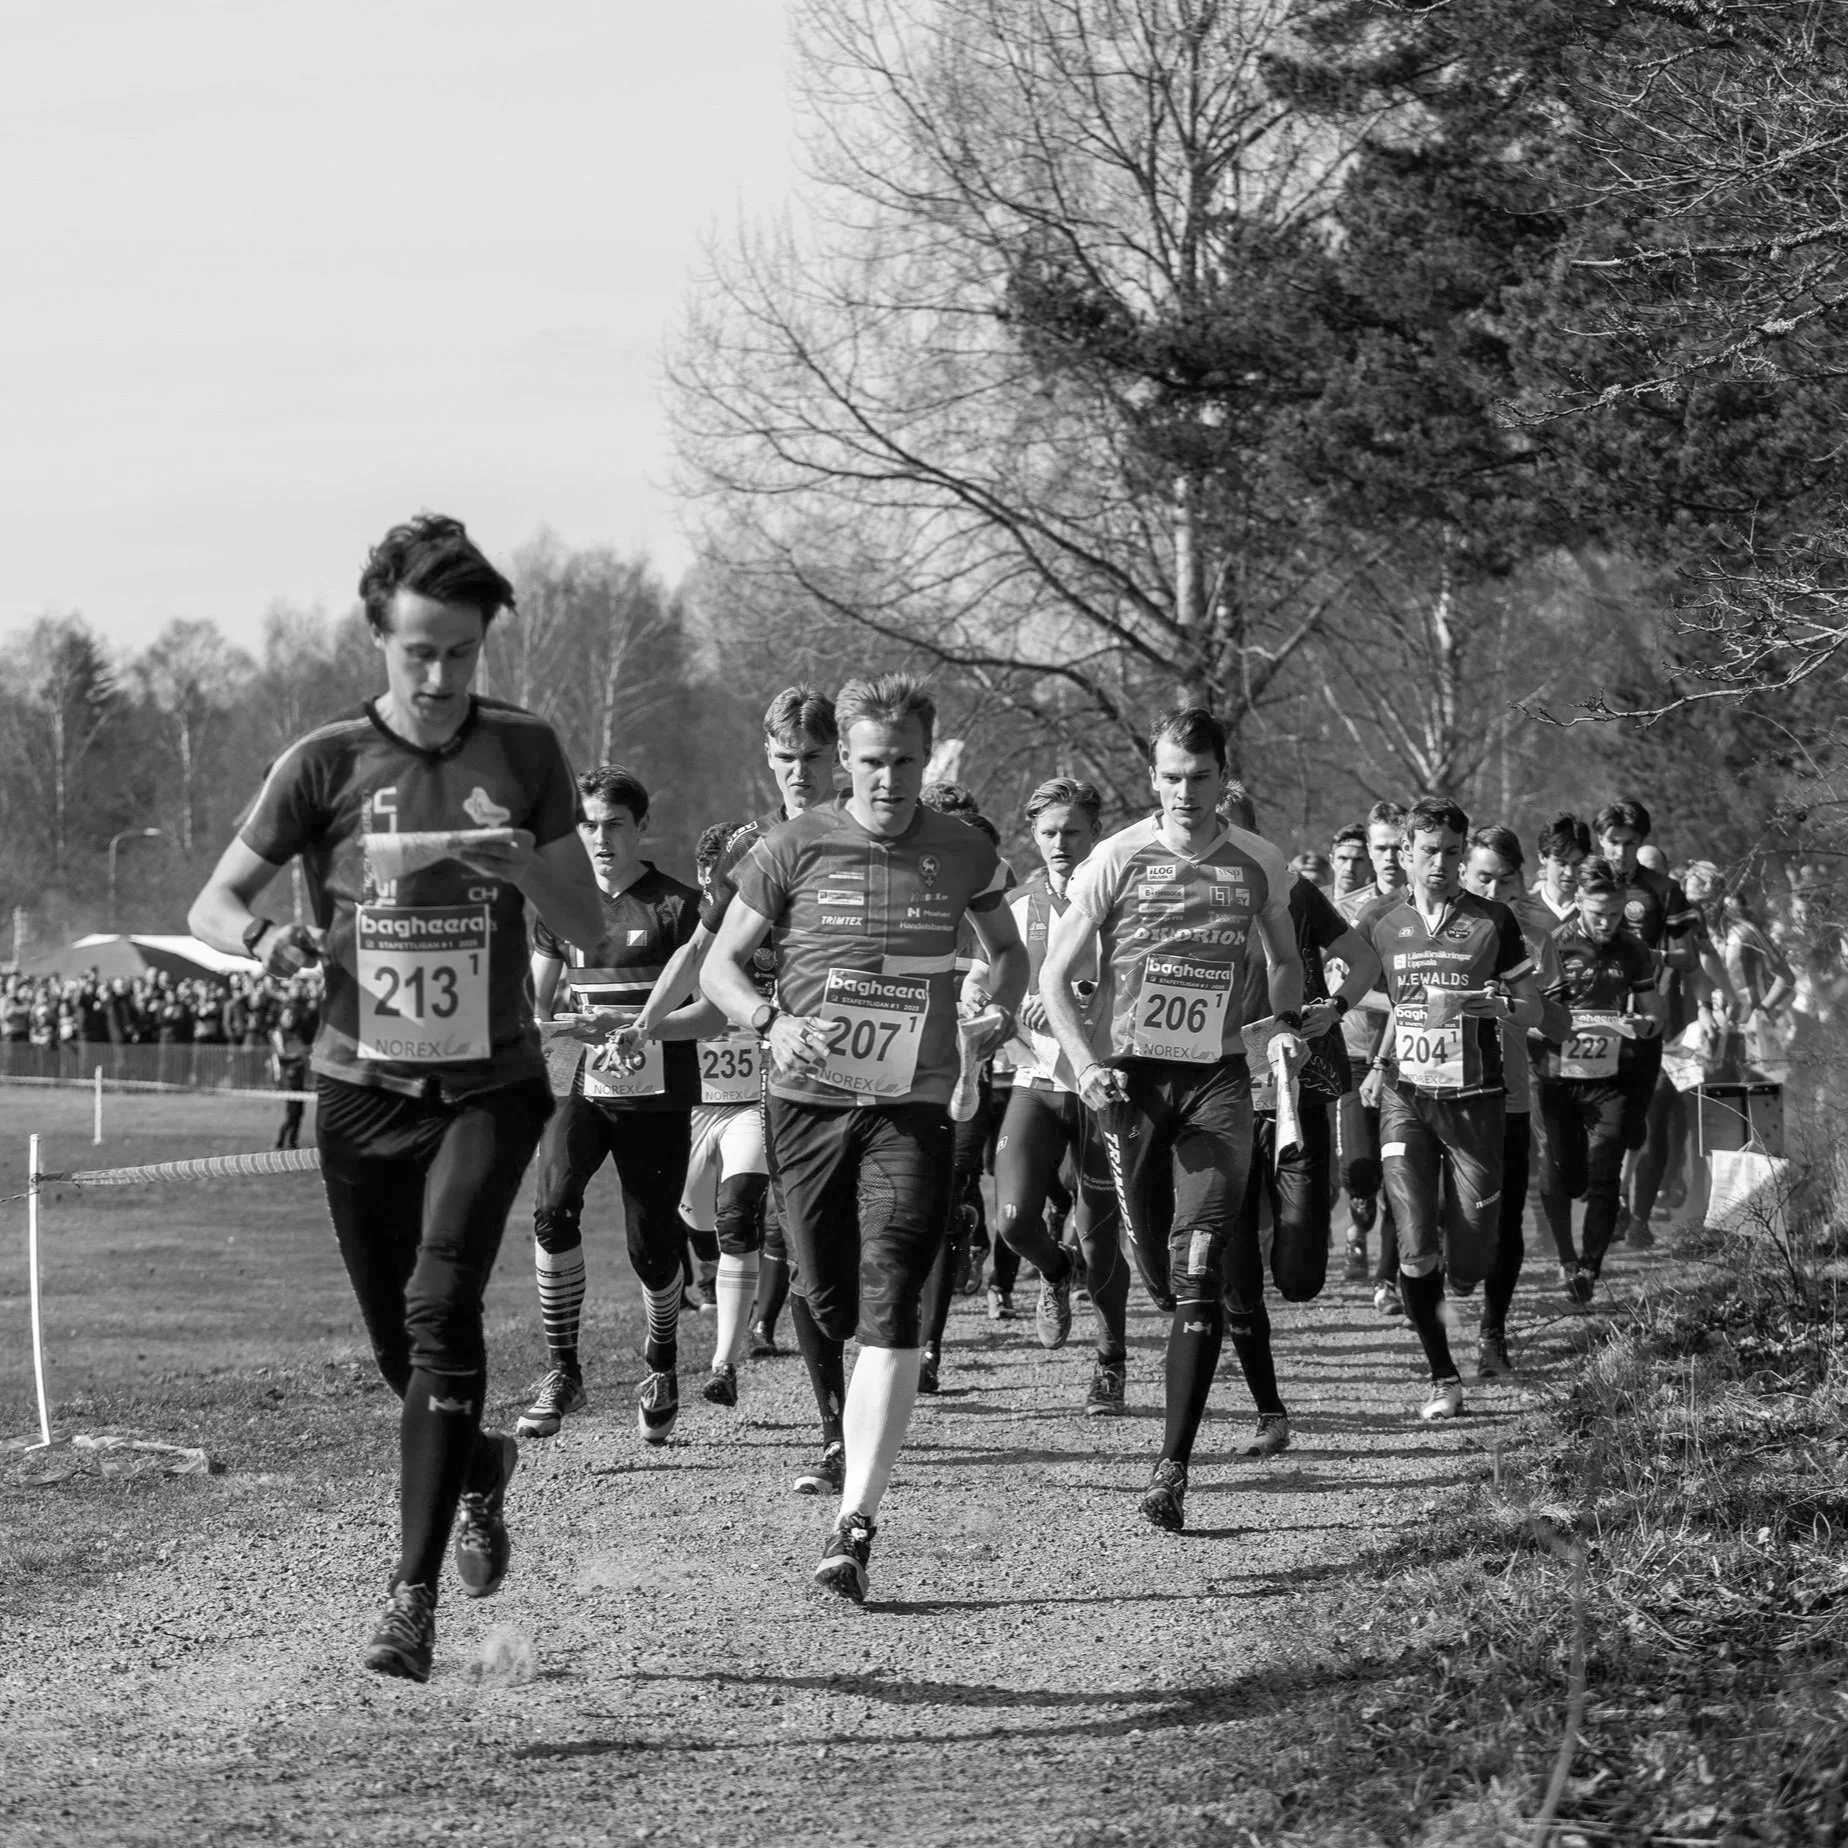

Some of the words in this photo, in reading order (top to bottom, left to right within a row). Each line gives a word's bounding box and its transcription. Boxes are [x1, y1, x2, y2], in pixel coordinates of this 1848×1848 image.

[361, 914, 485, 938] bagheera
[821, 915, 864, 926] TRIMTEX
[468, 953, 479, 976] 1
[1149, 958, 1231, 980] bagheera
[374, 966, 459, 1019] 213
[829, 974, 927, 1001] bagheera
[842, 996, 890, 1009] STAFETTLIGAN
[1216, 992, 1224, 1009] 1
[909, 1015, 918, 1033] 1
[1143, 993, 1209, 1034] 206
[826, 1015, 902, 1062] 207
[1451, 1030, 1457, 1043] 1
[375, 1038, 442, 1058] NOREX
[1142, 1043, 1191, 1059] NOREX
[1402, 1034, 1449, 1064] 204
[1567, 1036, 1609, 1060] 222
[703, 1048, 754, 1079] 235
[594, 1084, 636, 1095] NOREX
[819, 1067, 876, 1092] NOREX
[705, 1090, 744, 1101] NOREX
